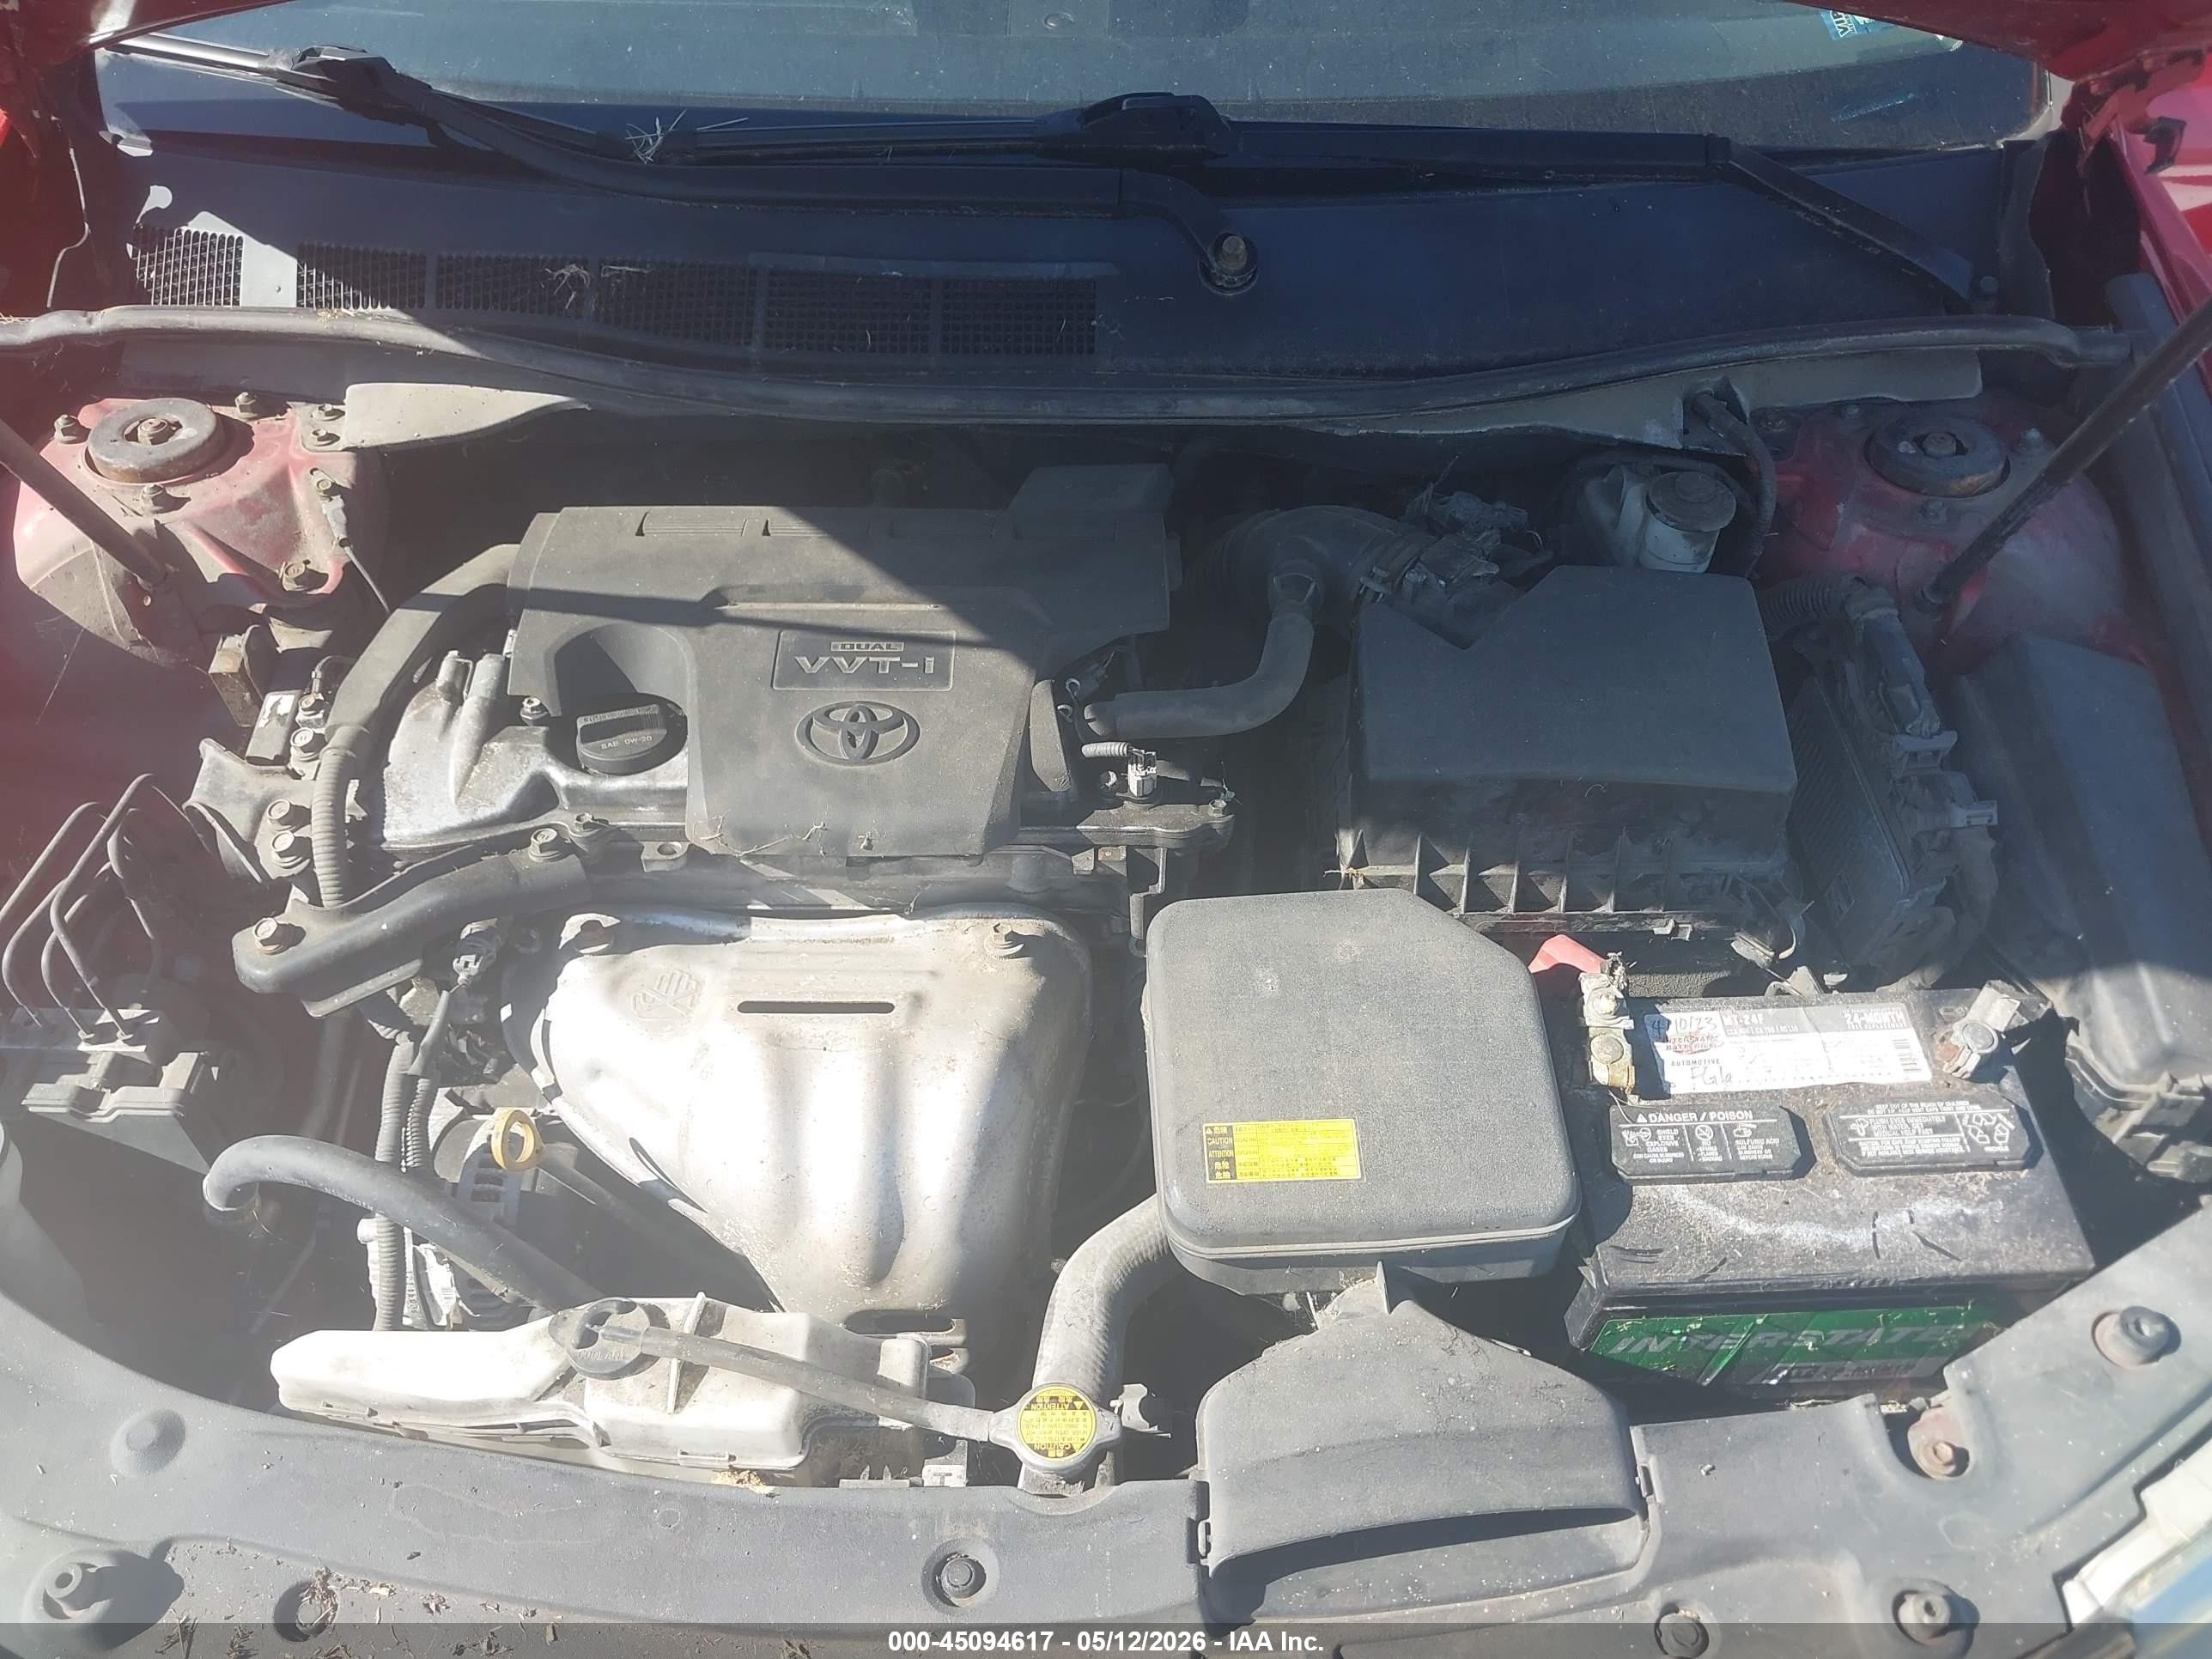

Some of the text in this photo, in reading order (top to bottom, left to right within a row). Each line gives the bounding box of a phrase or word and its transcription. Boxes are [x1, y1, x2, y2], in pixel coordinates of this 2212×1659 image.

[1670, 1058, 1720, 1066] AUTOMOTIVE
[1648, 1112, 1698, 1122] DANGER
[1709, 1110, 1753, 1121] POISON
[1207, 1137, 1233, 1146] CAUTION
[1208, 1150, 1235, 1158] ATTENTION
[1607, 1326, 1952, 1354] INTERSTATE
[578, 1351, 625, 1361] COOLANT
